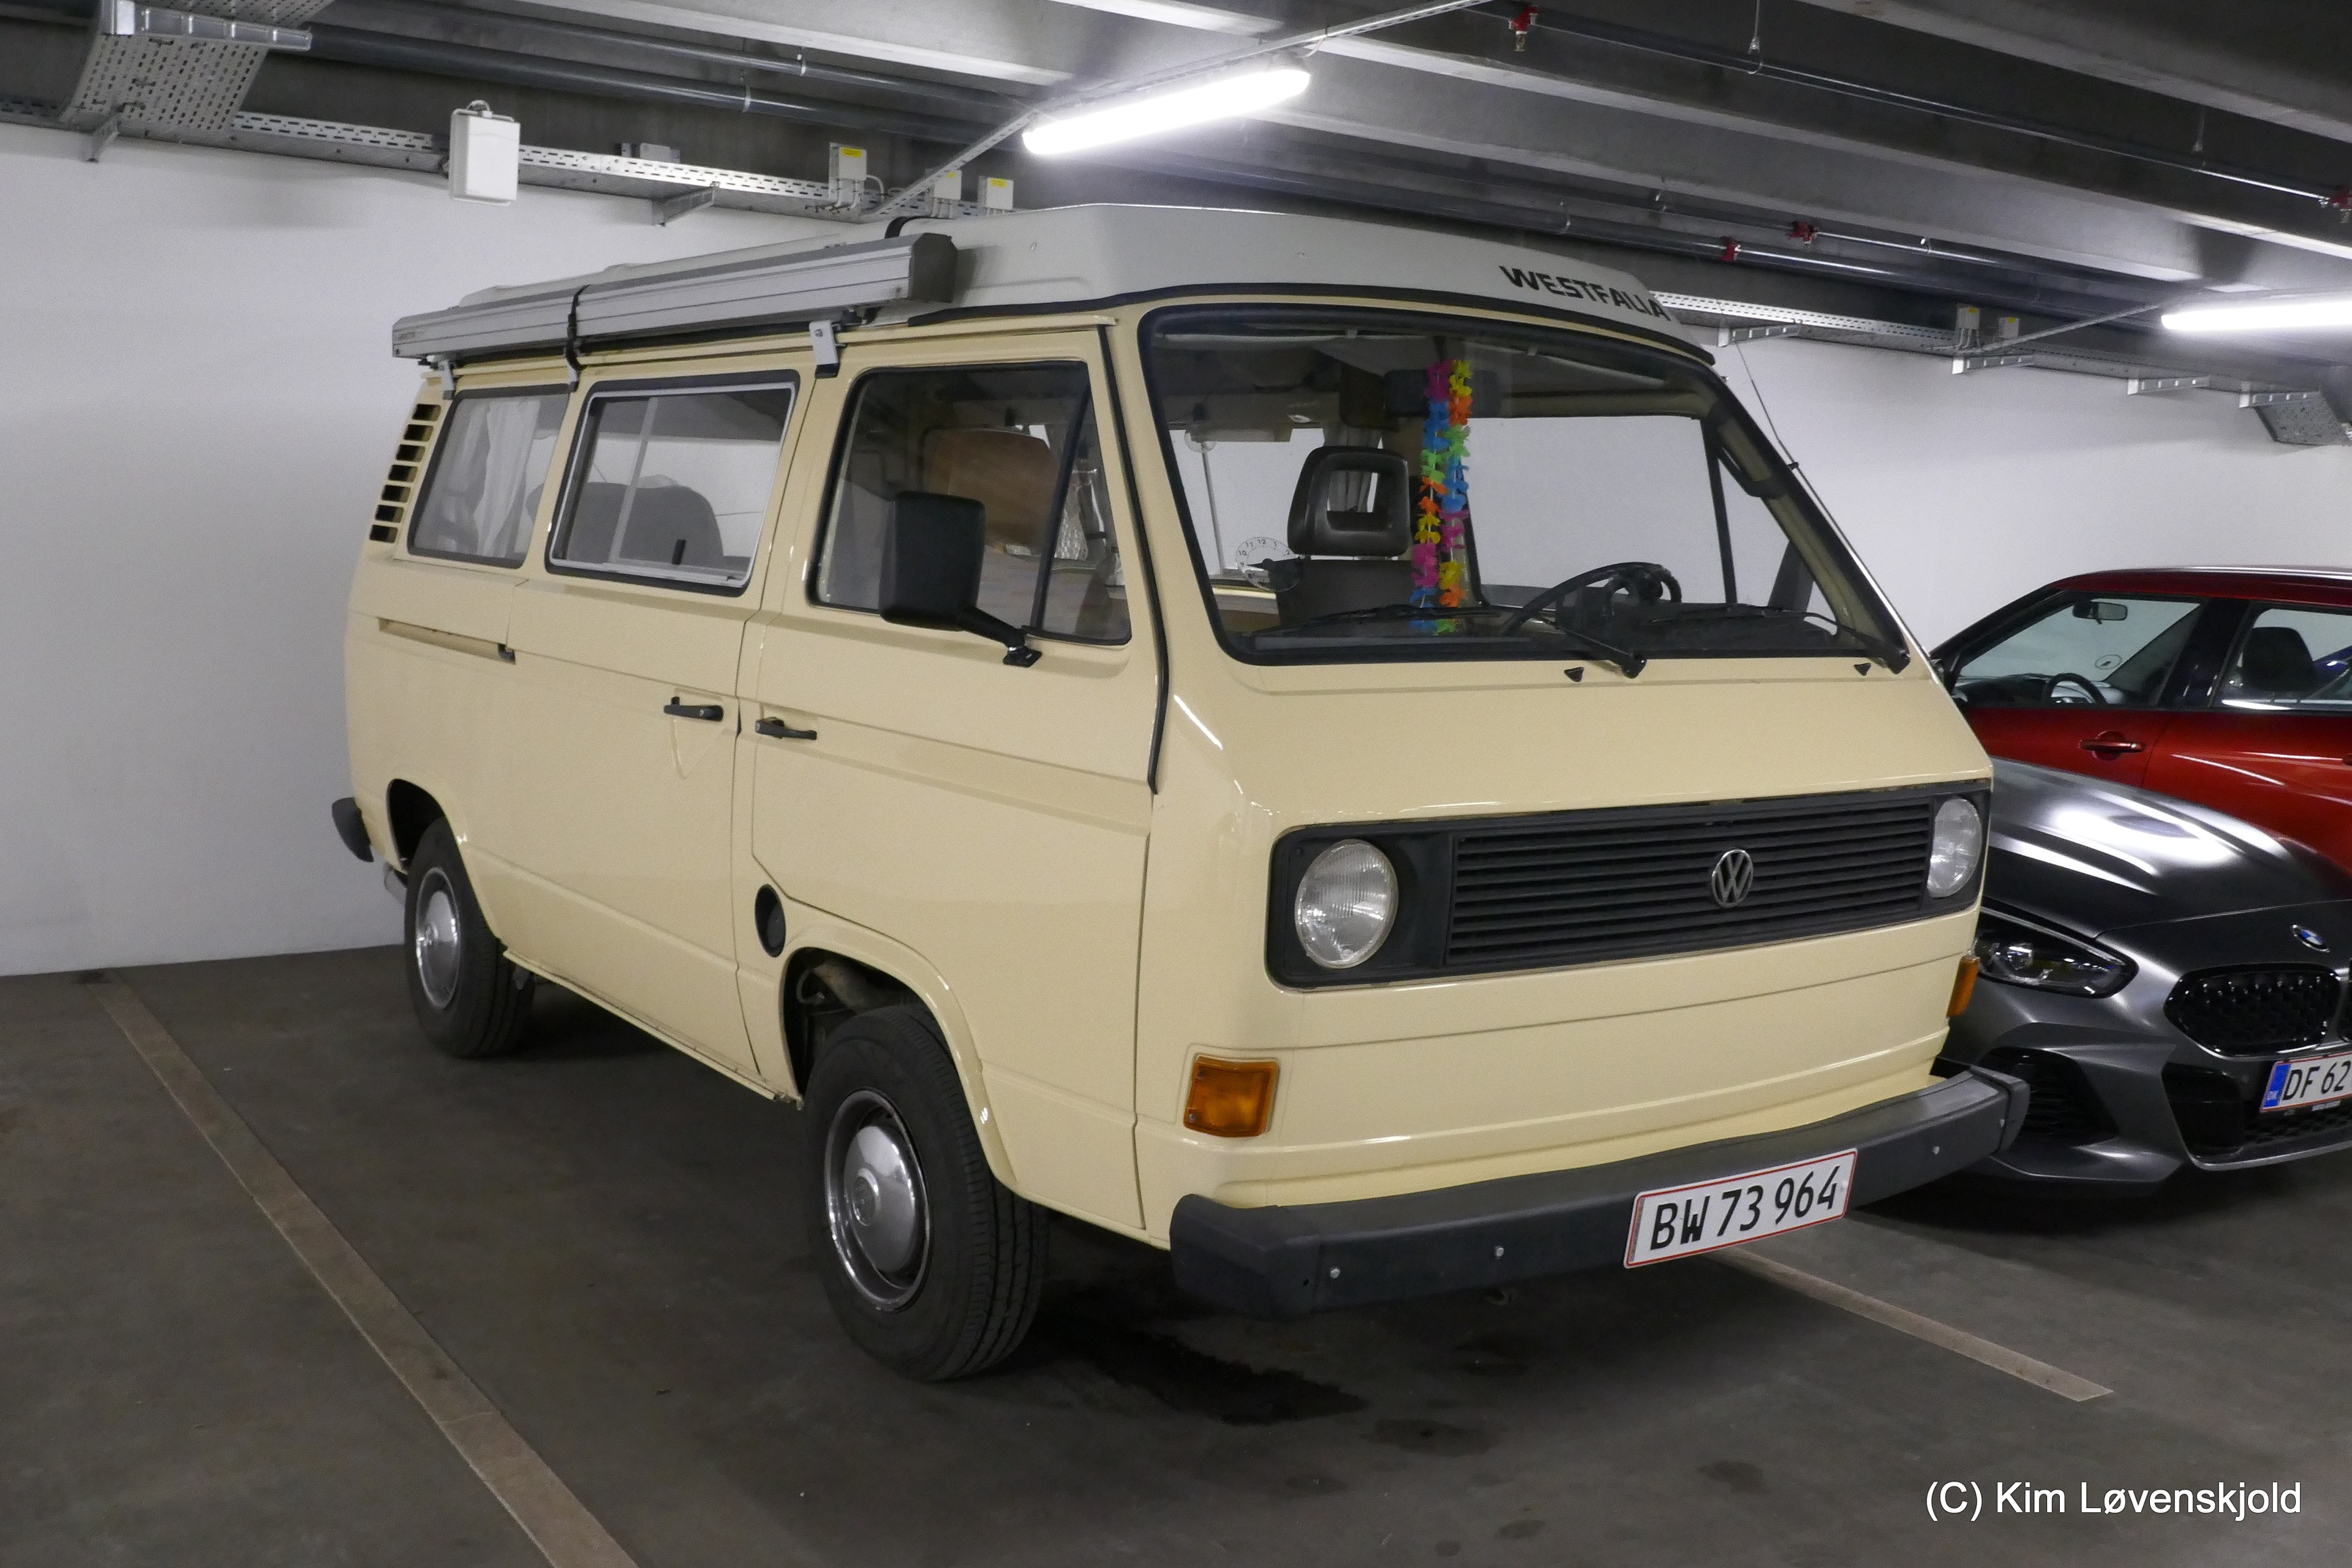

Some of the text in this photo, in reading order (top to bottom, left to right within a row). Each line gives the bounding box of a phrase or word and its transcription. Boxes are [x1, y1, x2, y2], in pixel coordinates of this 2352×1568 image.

[1499, 265, 1671, 322] WESTFALIA
[2282, 1060, 2351, 1101] DF 62
[1650, 1165, 1840, 1251] BW 73 964
